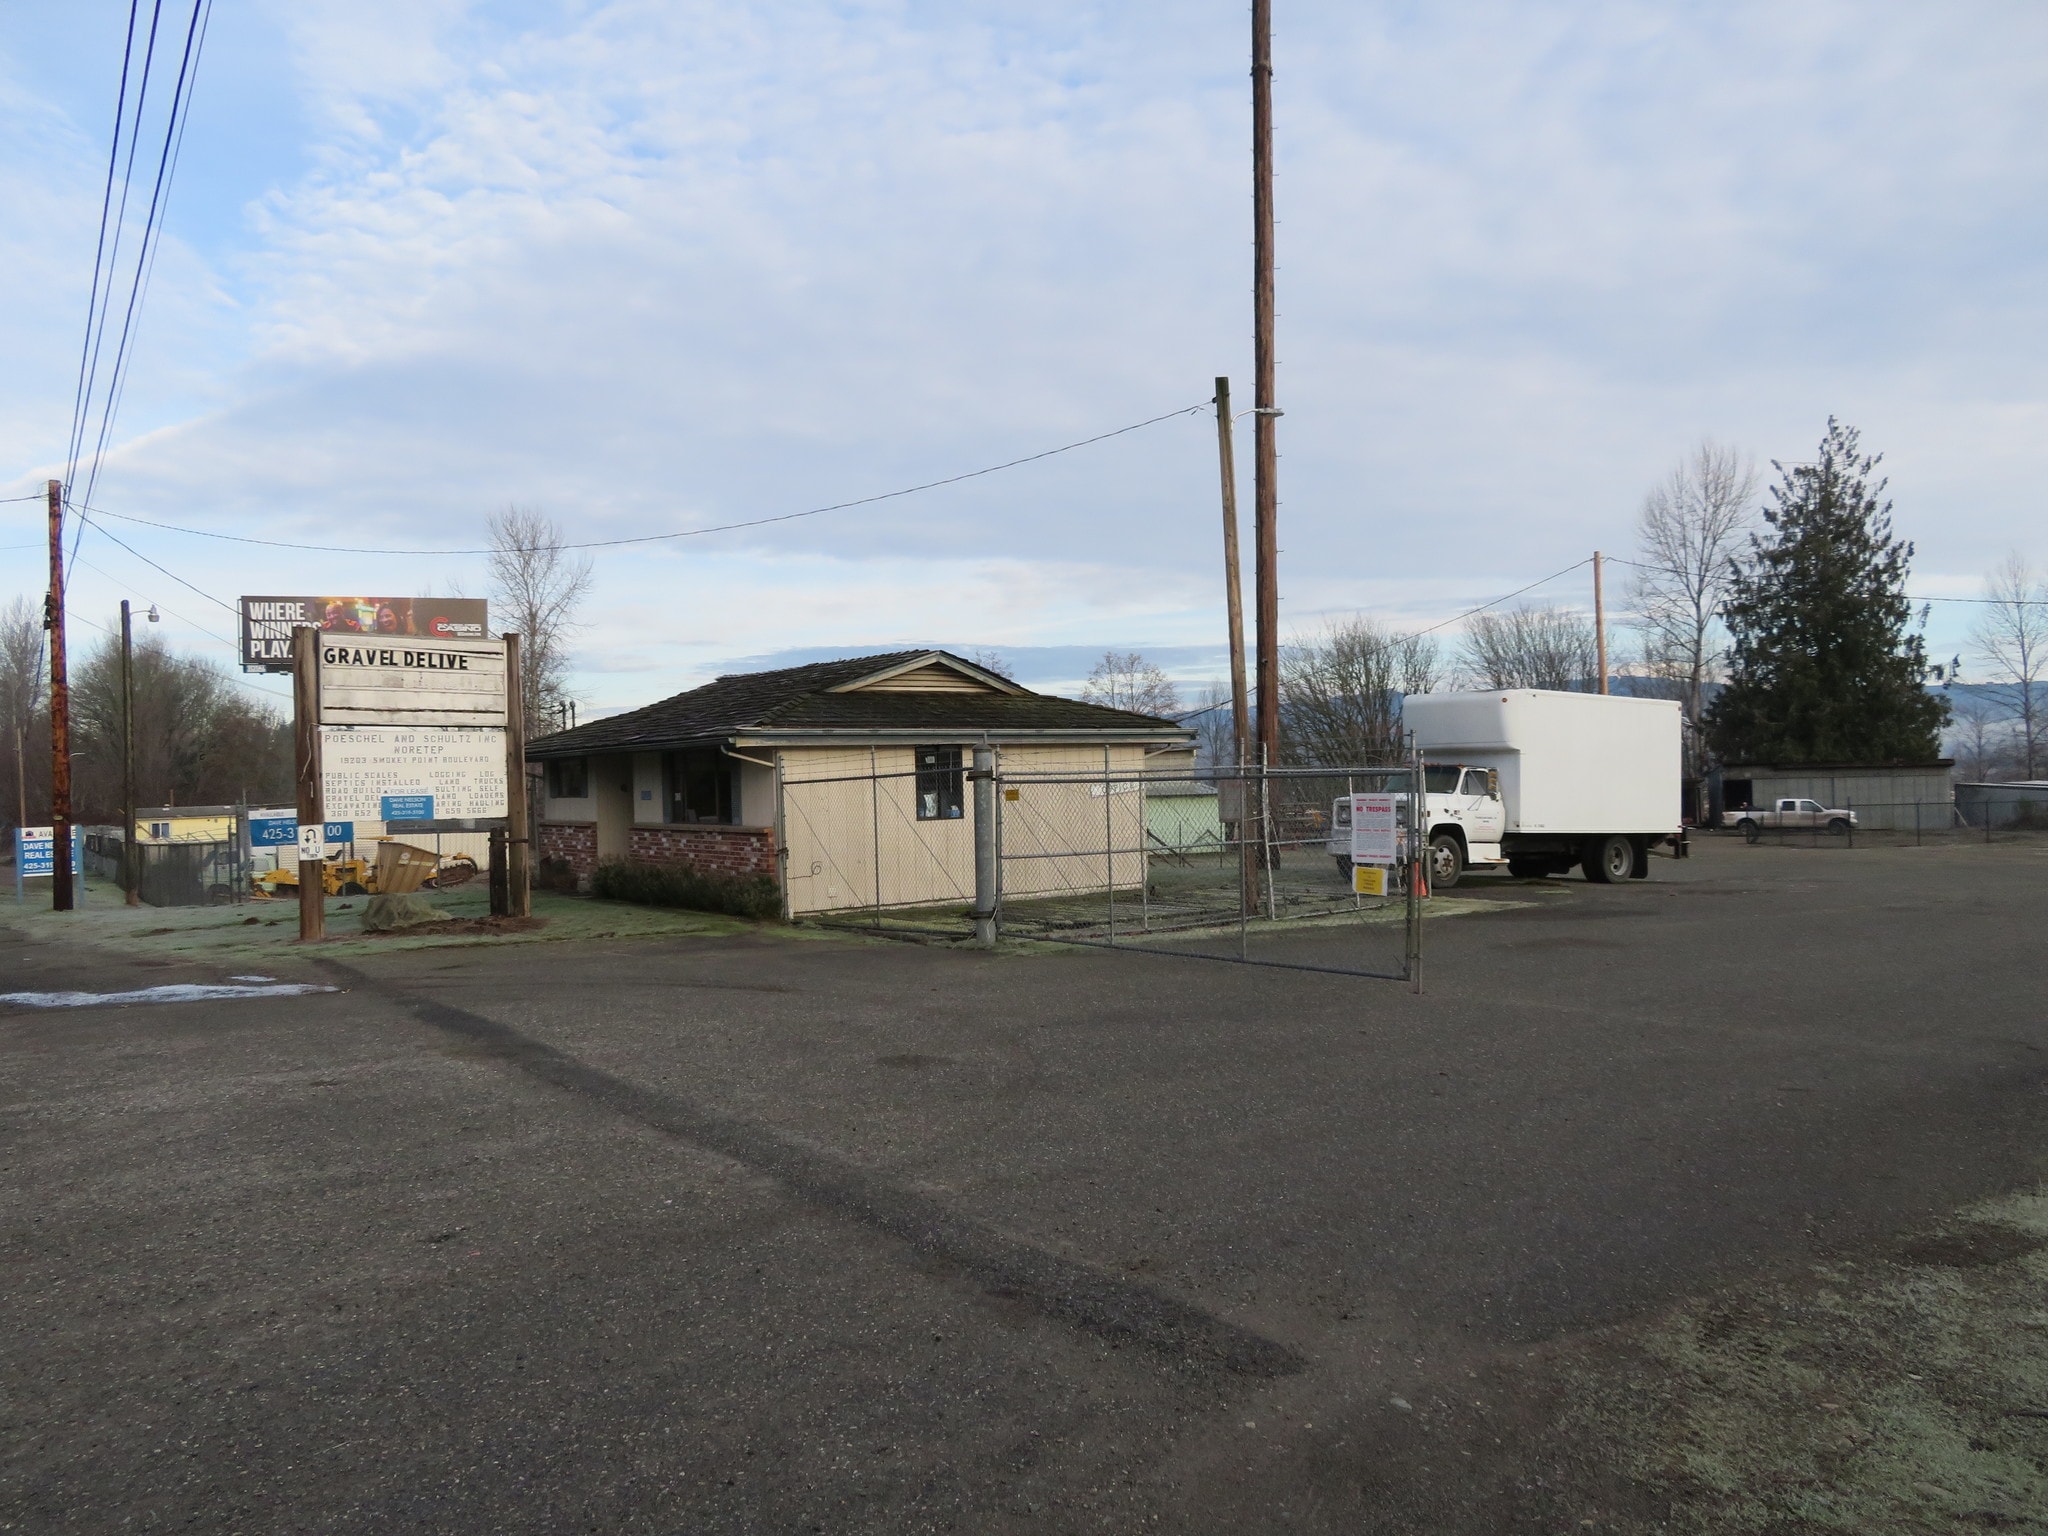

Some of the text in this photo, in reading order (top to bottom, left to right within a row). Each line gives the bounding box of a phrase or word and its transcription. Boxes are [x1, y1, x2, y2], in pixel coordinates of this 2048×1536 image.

[249, 602, 306, 620] WHERE
[250, 621, 322, 639] WINN
[250, 641, 293, 658] PLAY.
[324, 648, 468, 670] GRAVEL DELIVE
[324, 734, 497, 743] POESCHEL AND SCHULTZ INC
[394, 746, 444, 754] NORETEP
[25, 851, 45, 859] REAL
[301, 846, 320, 854] NO U
